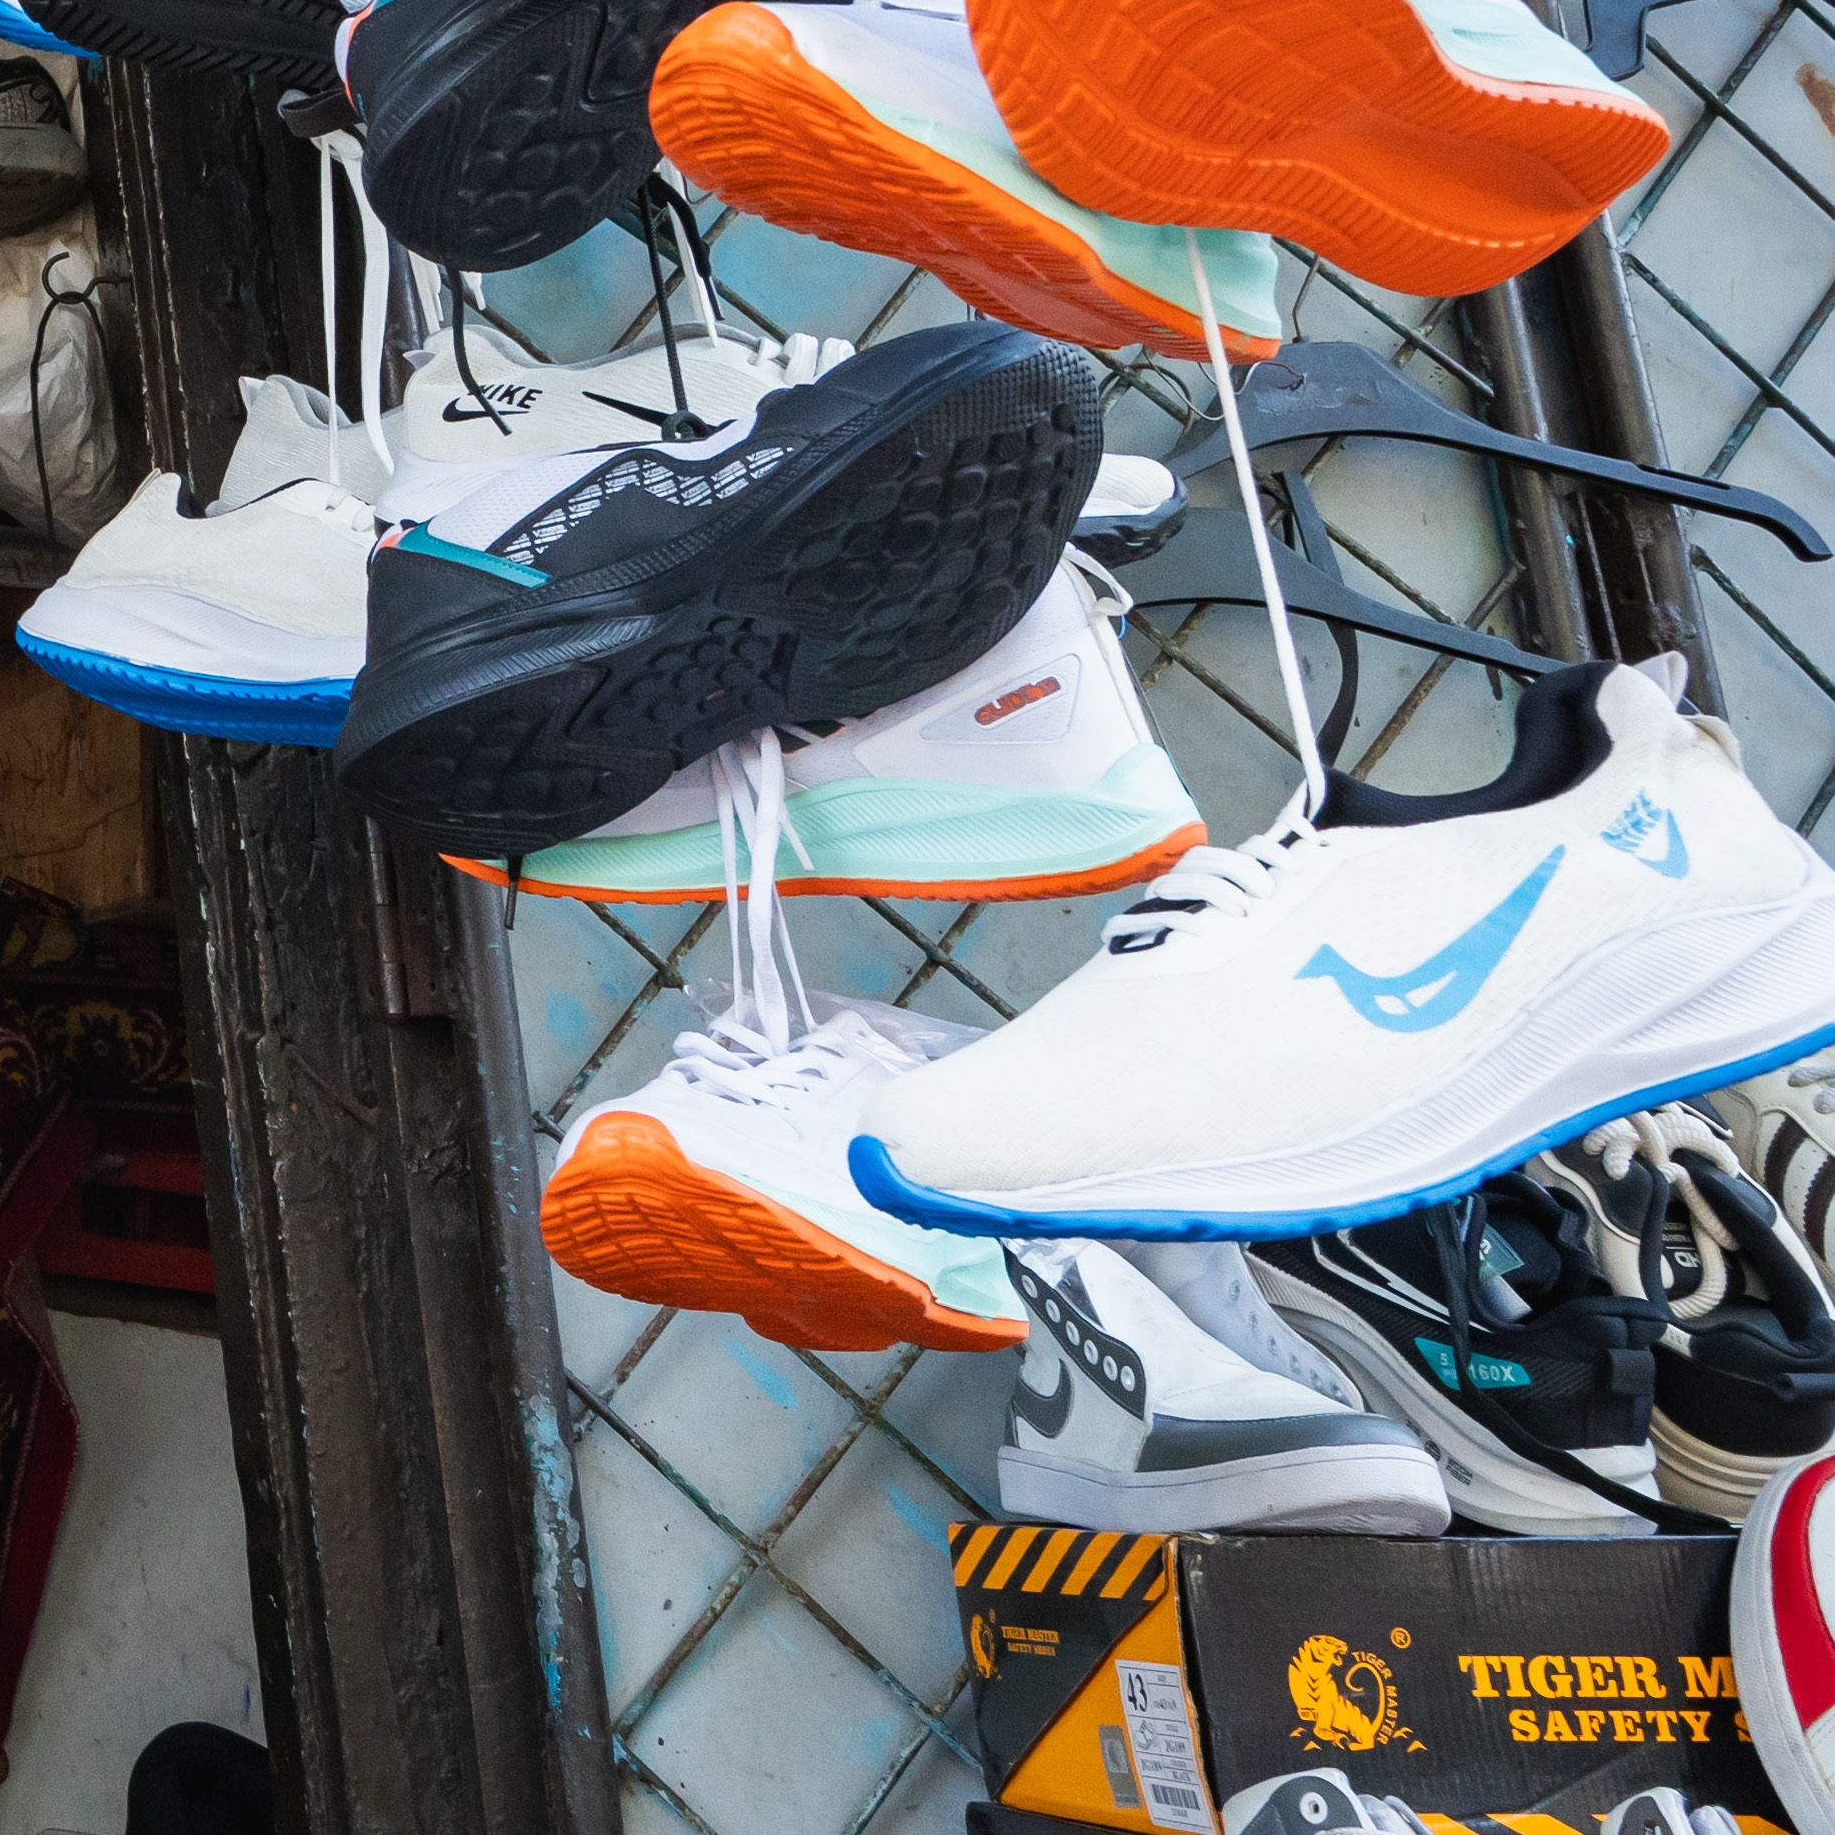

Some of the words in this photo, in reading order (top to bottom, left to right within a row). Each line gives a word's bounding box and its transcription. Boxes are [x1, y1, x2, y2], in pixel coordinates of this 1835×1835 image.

[1350, 1650, 1394, 1680] TIGER
[1457, 1654, 1667, 1699] TIGER
[1128, 1672, 1148, 1713] 43
[1508, 1709, 1712, 1743] SAFETY
